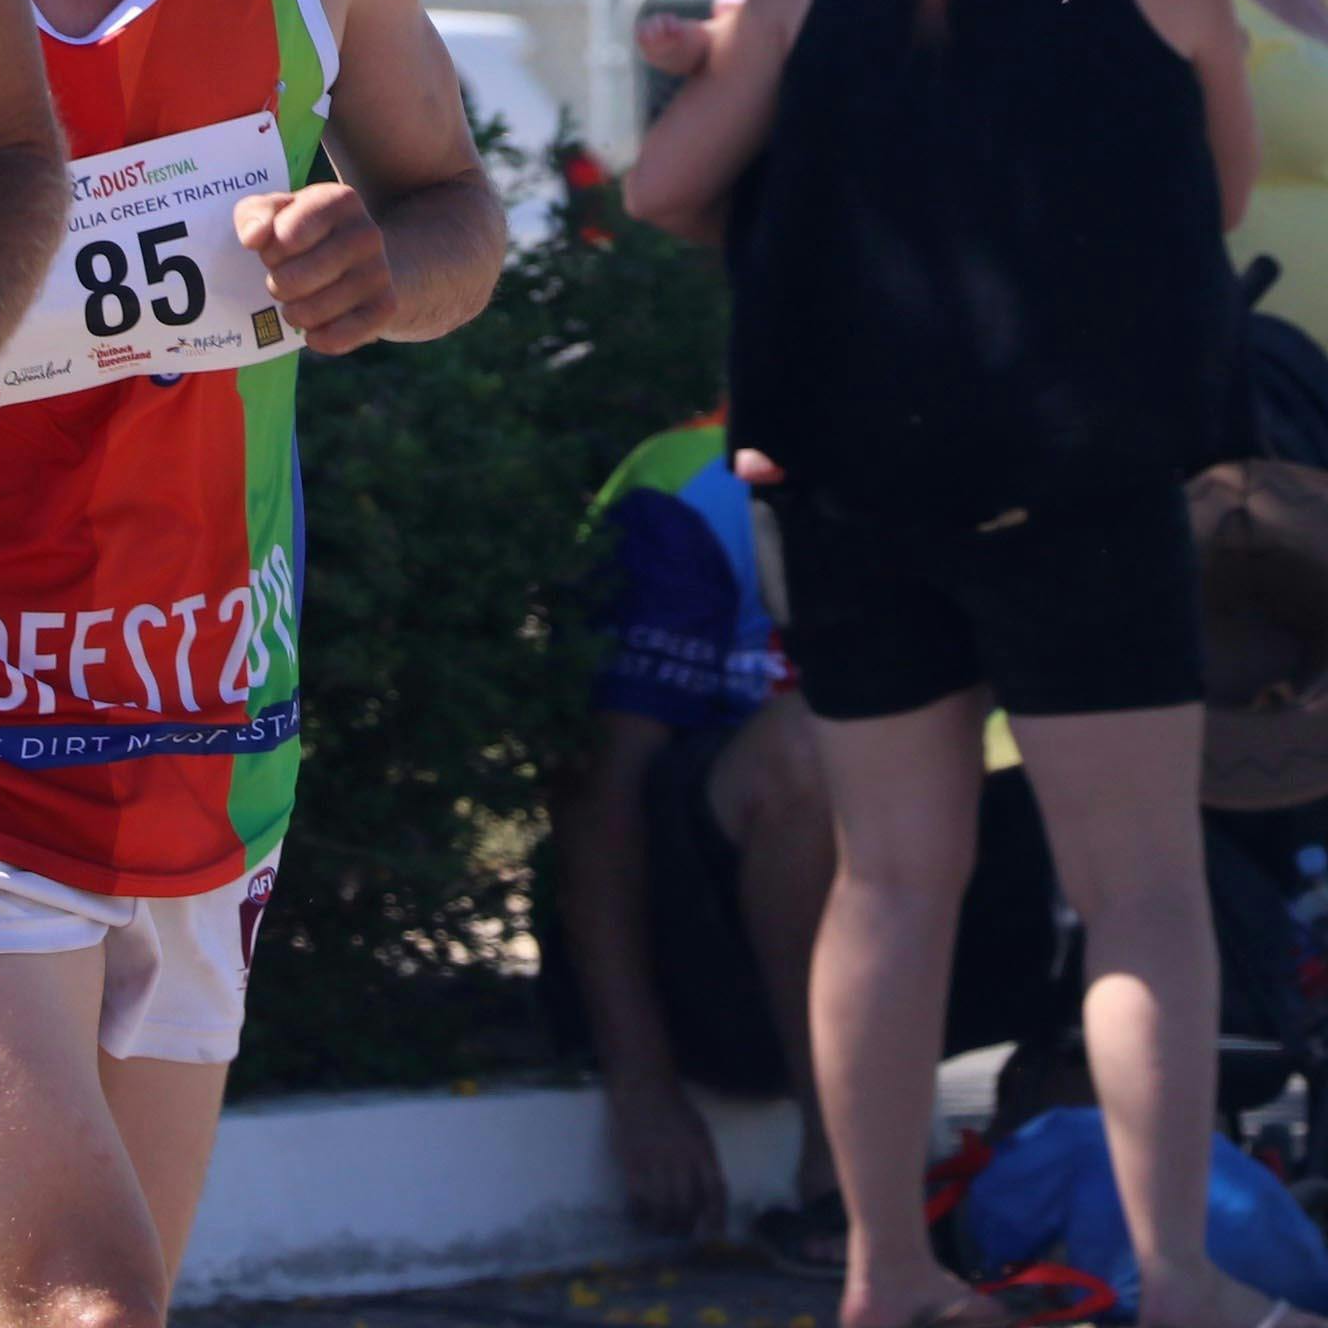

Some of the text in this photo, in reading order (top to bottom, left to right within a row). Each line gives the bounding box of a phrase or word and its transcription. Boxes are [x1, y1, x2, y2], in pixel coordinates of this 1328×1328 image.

[99, 160, 147, 198] DUST
[146, 157, 199, 184] FESTIVAL
[110, 194, 171, 222] CREEK
[173, 168, 270, 206] TRIATHLON
[74, 221, 207, 338] 85
[3, 359, 73, 386] Queensland
[20, 734, 113, 759] DIRT
